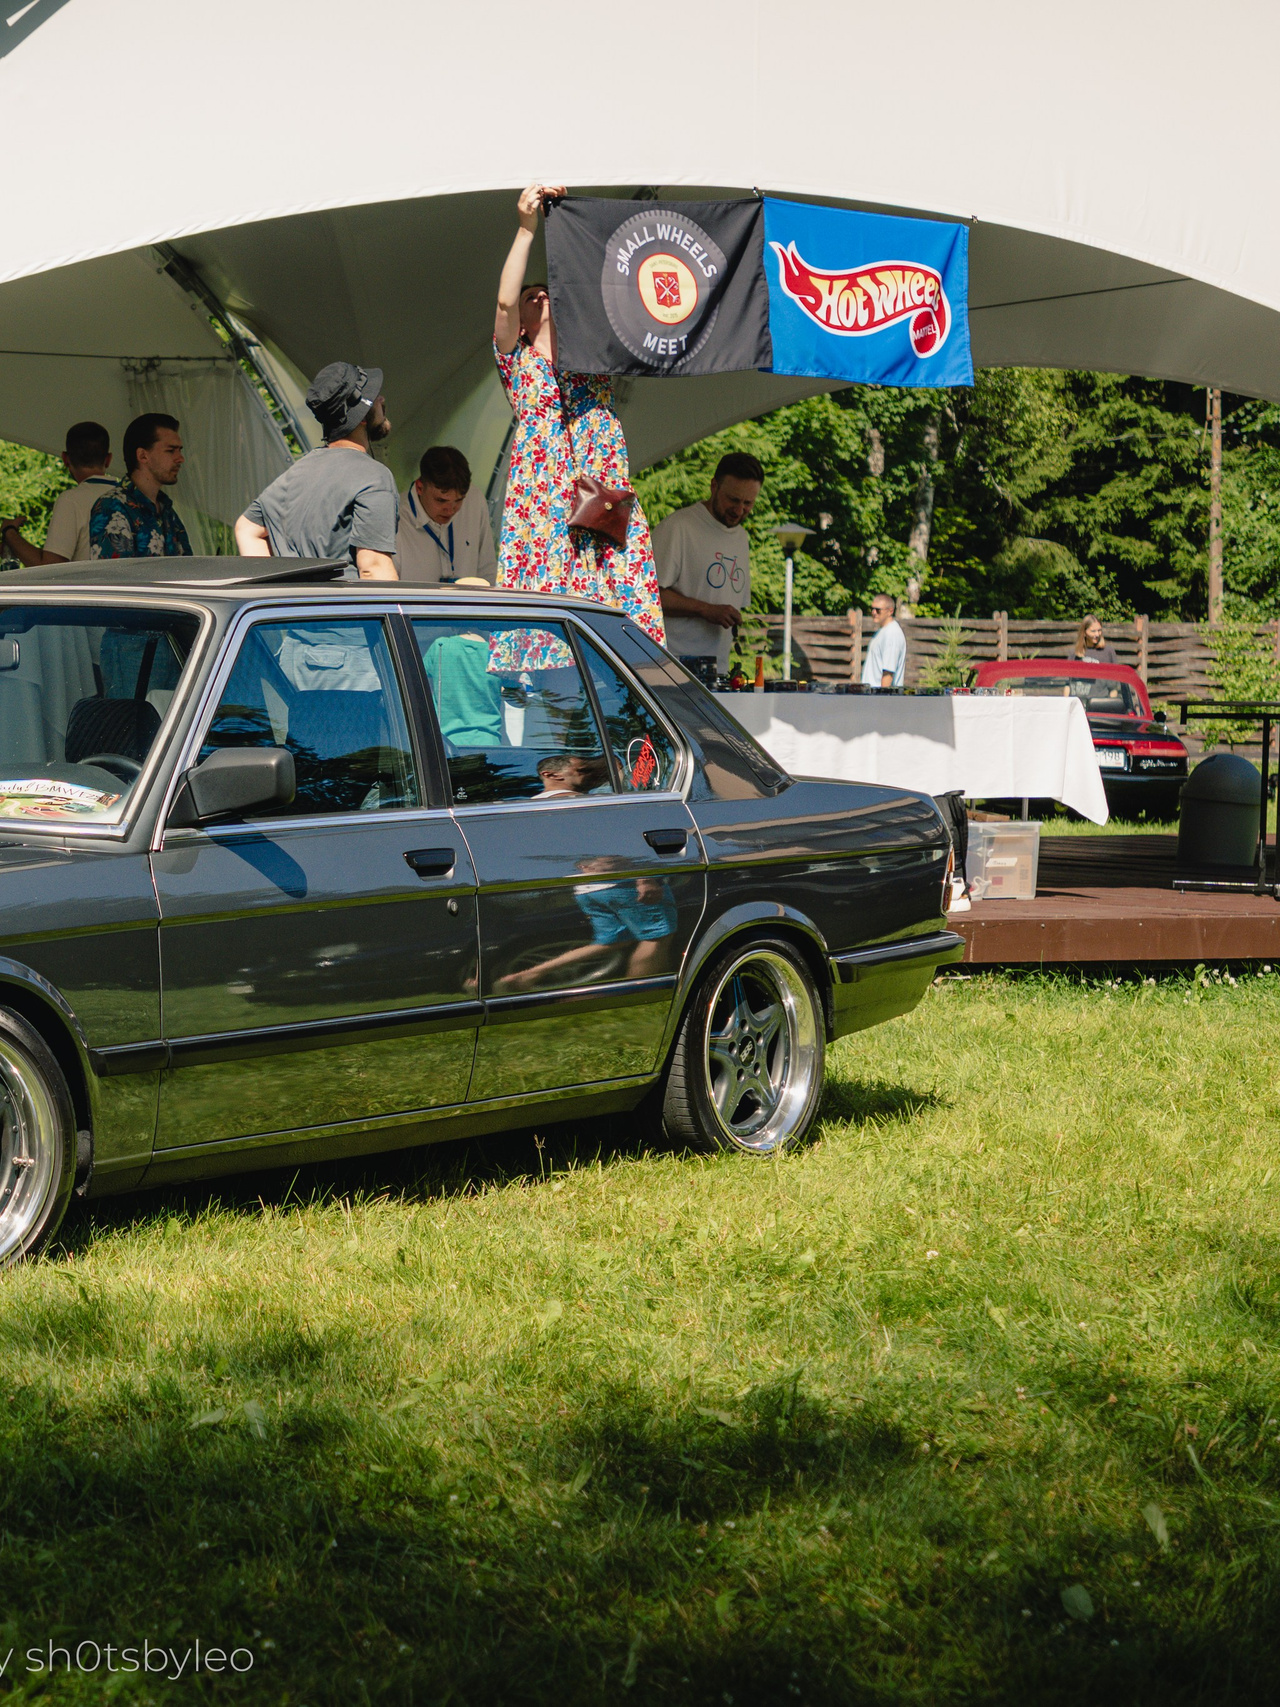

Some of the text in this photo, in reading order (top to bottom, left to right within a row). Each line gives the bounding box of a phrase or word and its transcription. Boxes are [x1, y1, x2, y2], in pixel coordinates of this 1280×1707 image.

[616, 223, 718, 279] SMALL WHEELS
[808, 275, 868, 328] Hot
[912, 323, 937, 340] MATTEL
[642, 332, 688, 356] MEET
[740, 1040, 754, 1062] BBS
